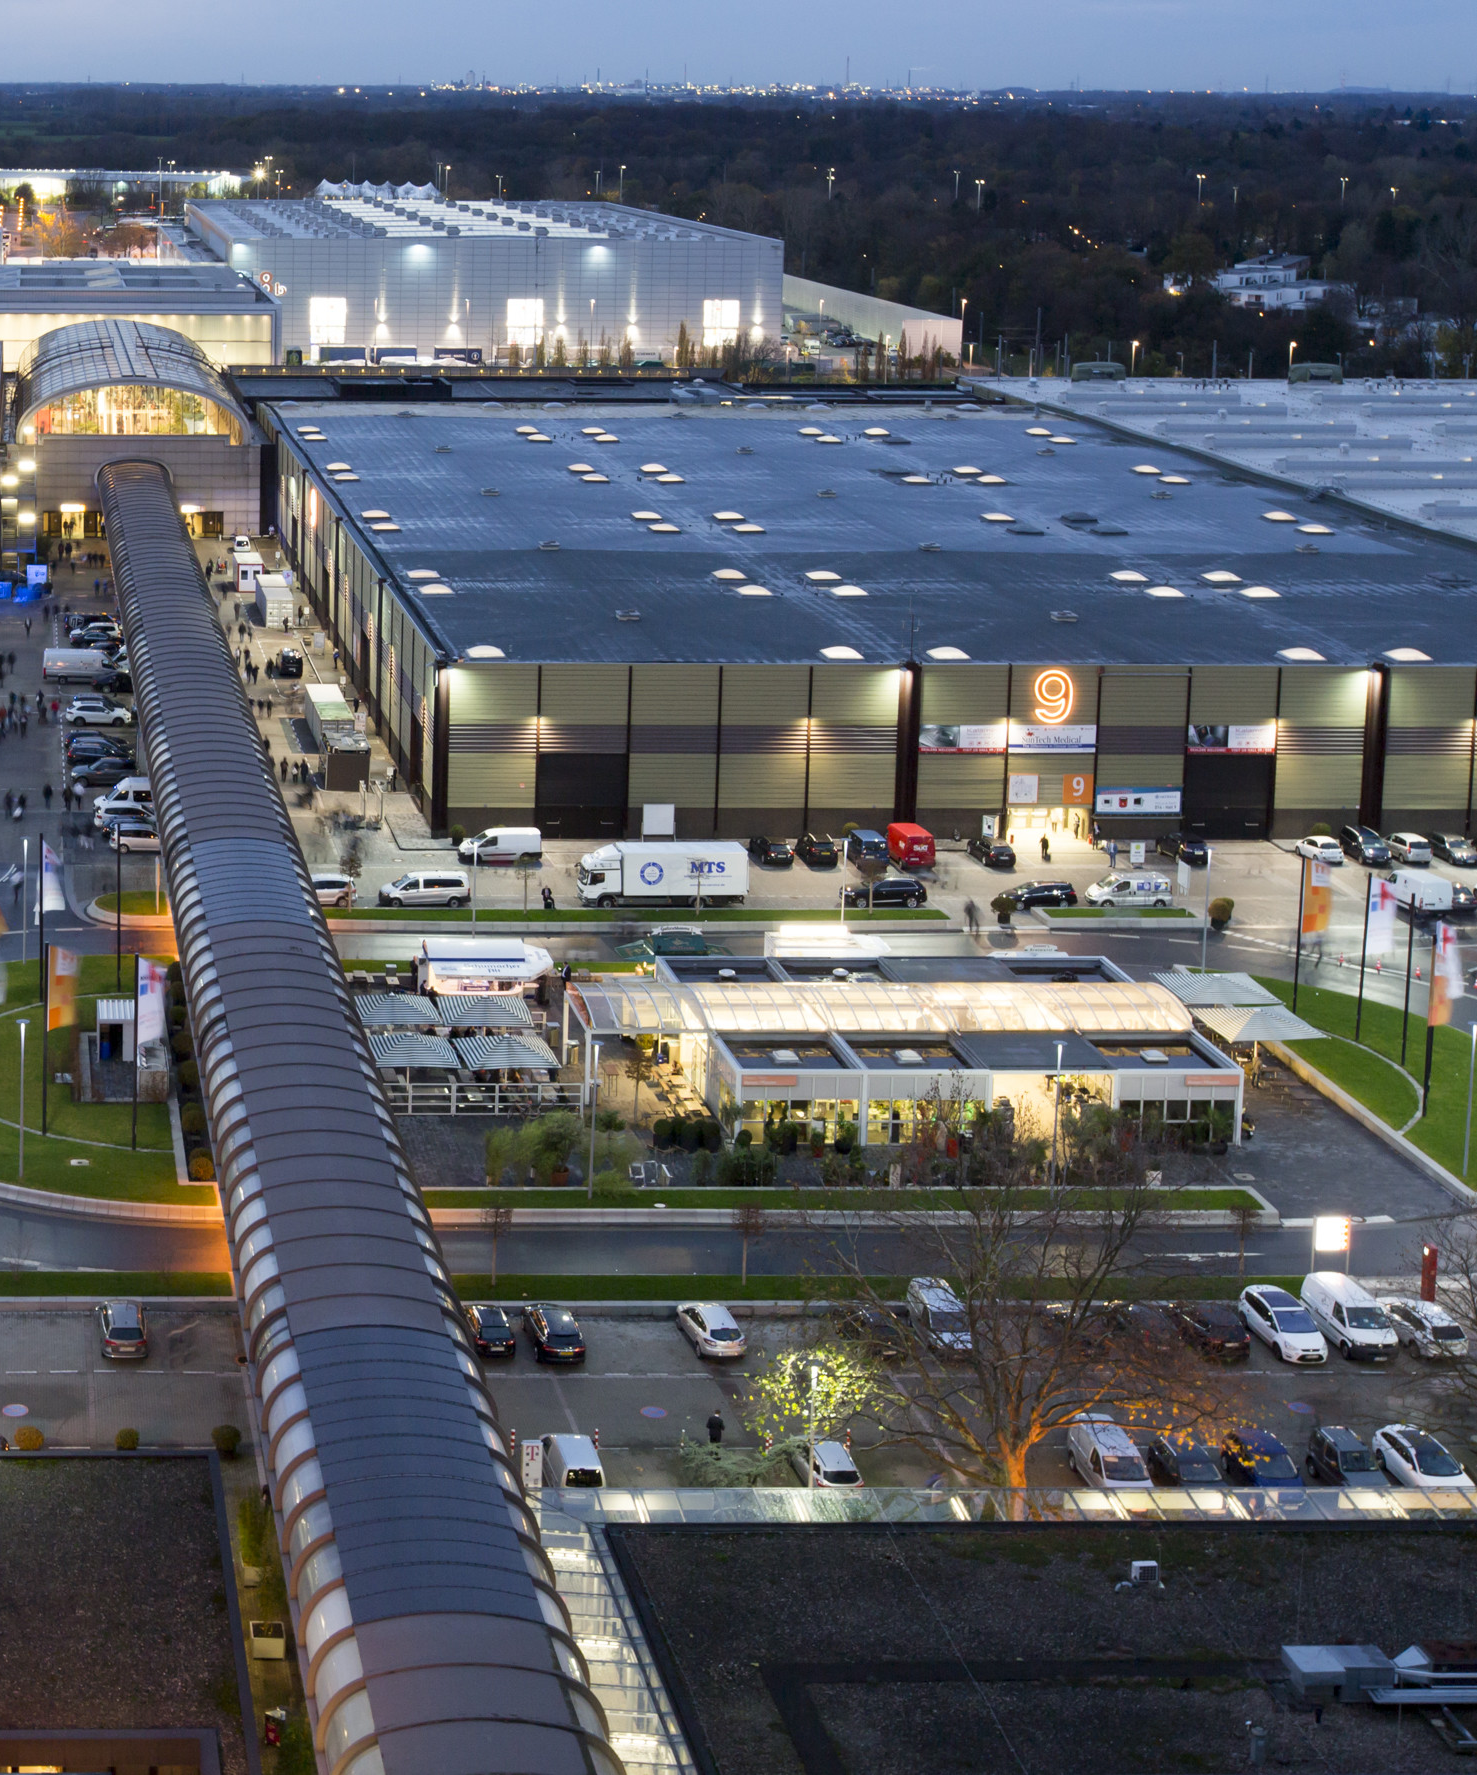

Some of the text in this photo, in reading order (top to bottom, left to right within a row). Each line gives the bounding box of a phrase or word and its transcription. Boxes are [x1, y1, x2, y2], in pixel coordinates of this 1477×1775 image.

[1034, 669, 1074, 724] 9
[1053, 736, 1082, 744] Medical
[1072, 776, 1085, 797] 9
[690, 861, 726, 874] MTS
[526, 1445, 539, 1461] T
